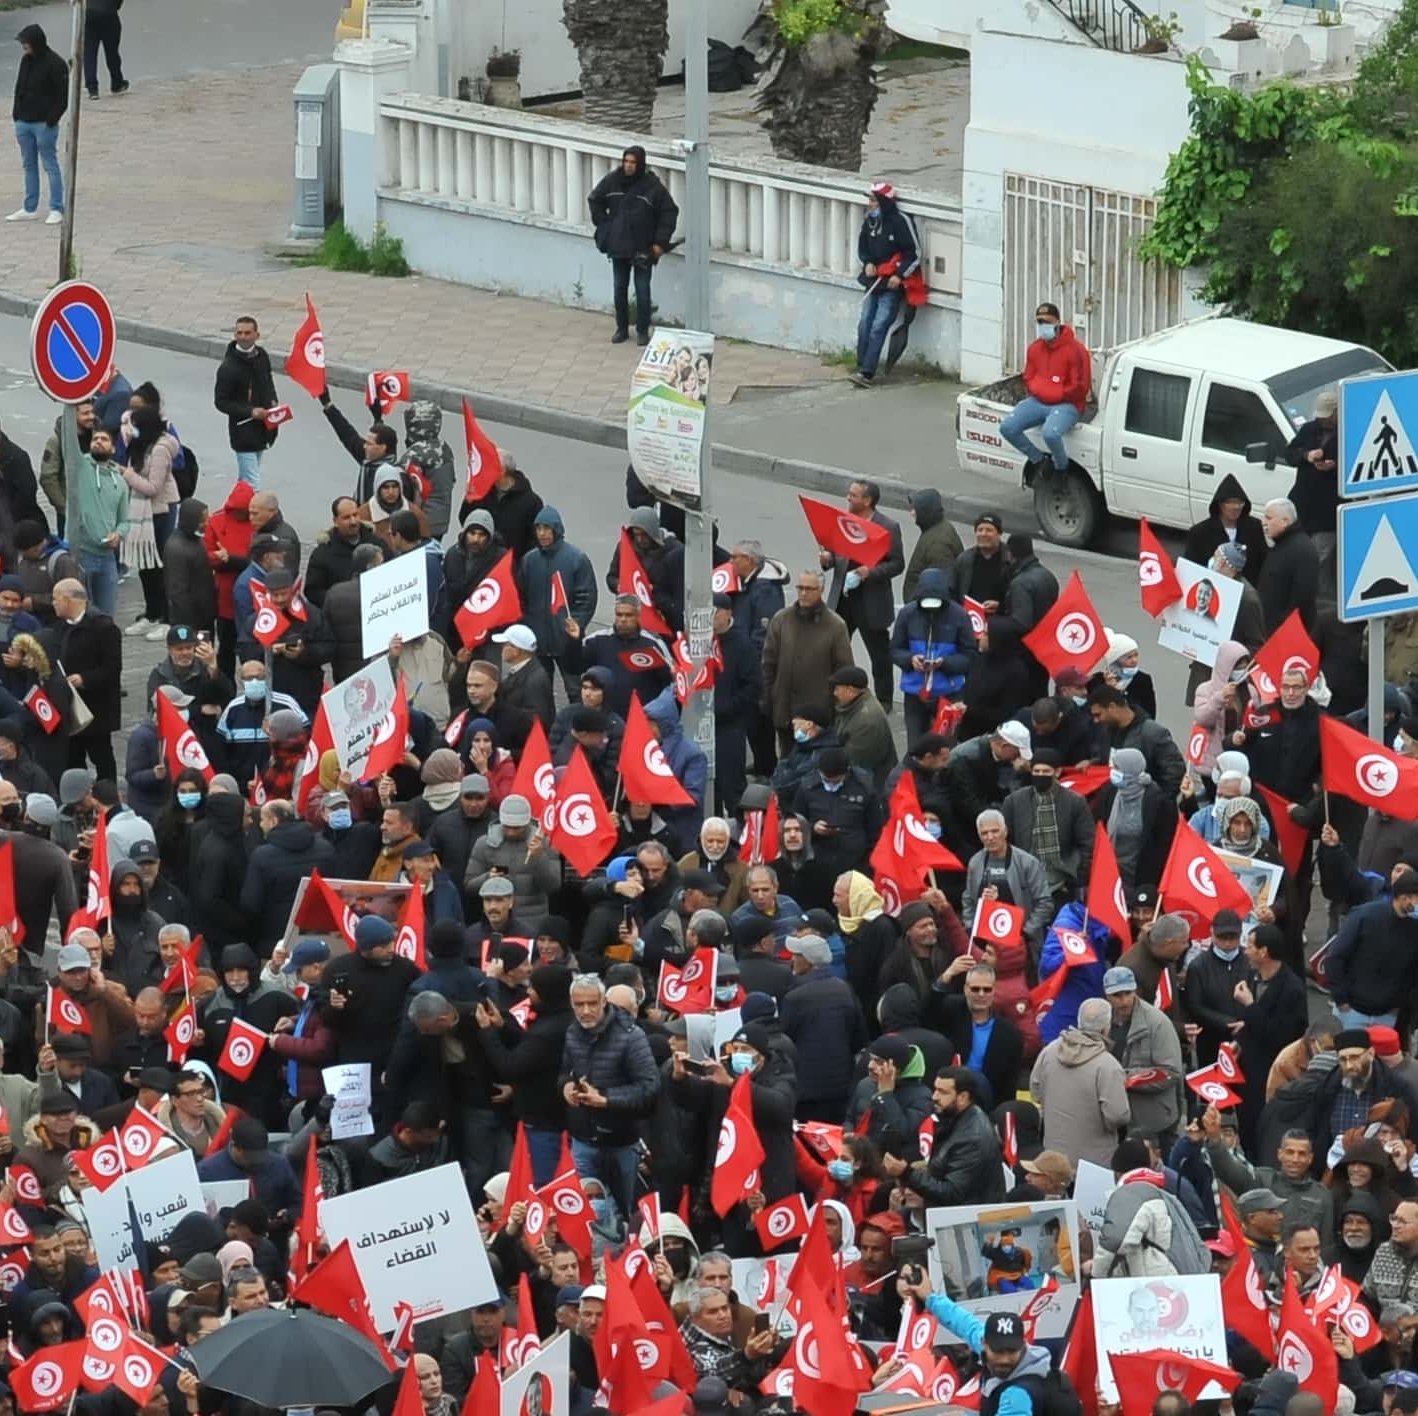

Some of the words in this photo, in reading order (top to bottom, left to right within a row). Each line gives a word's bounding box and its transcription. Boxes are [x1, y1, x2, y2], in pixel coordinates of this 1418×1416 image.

[966, 430, 1002, 447] ISUZU
[439, 1209, 451, 1227] لا
[385, 1241, 437, 1270] القضاء
